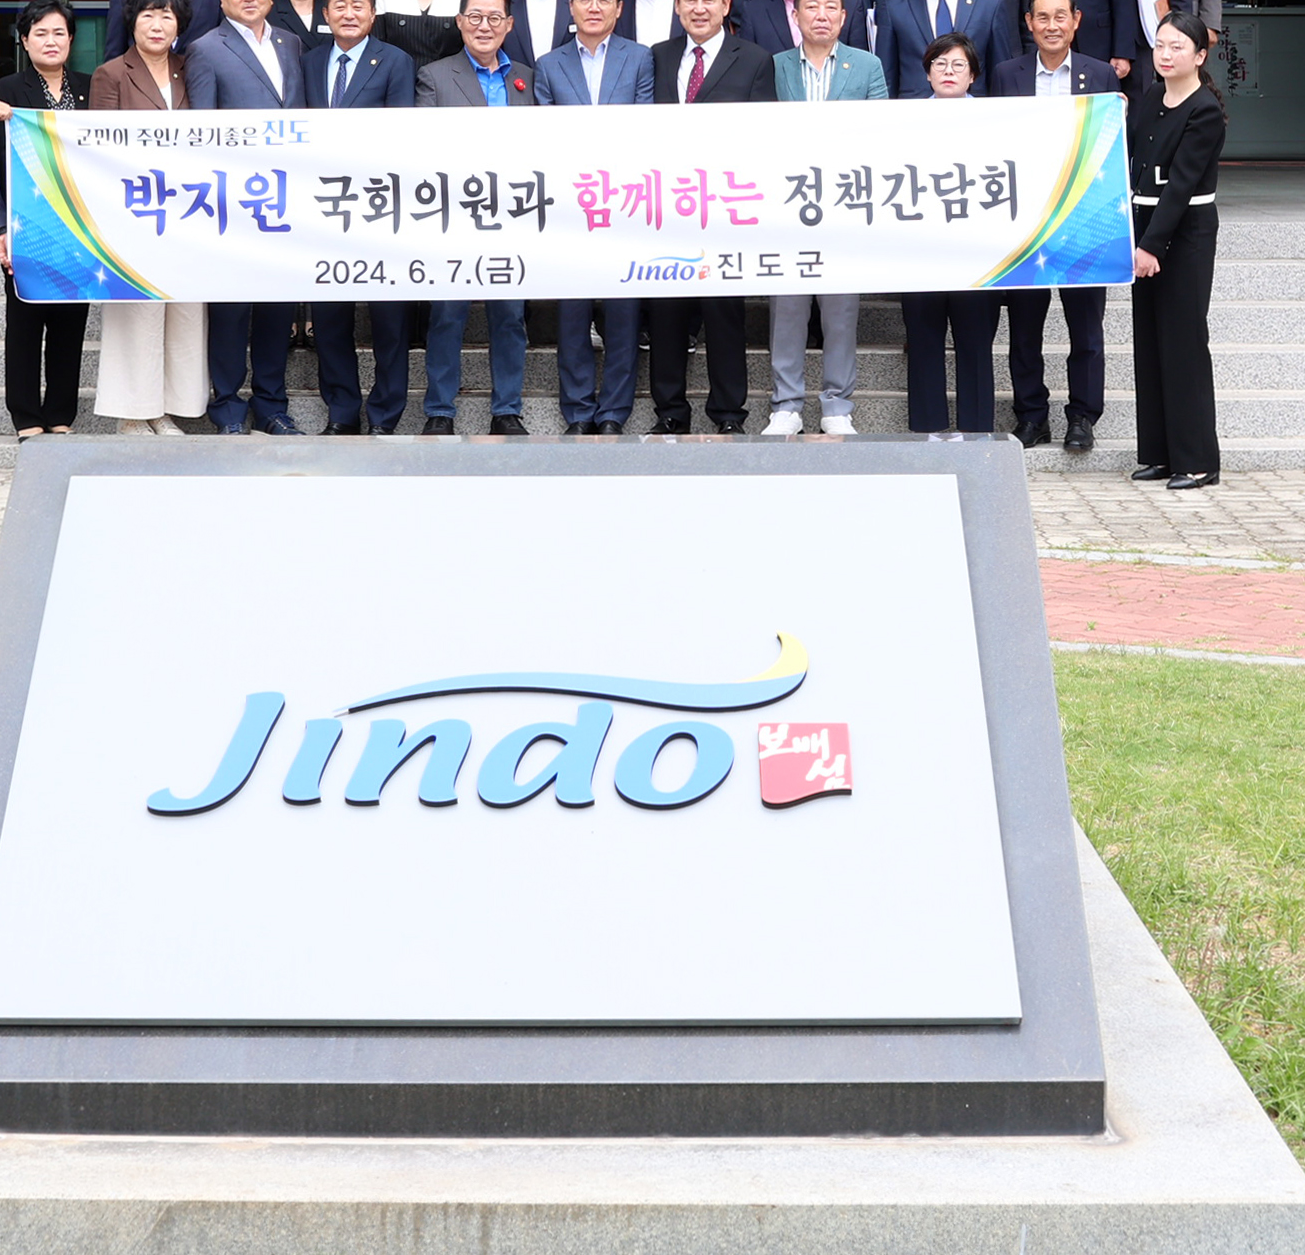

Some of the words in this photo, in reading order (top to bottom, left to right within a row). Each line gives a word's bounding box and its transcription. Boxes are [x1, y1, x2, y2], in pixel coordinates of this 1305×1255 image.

[77, 127, 129, 147] 군민이
[136, 127, 180, 148] 주인!
[186, 127, 258, 148] 살기좋은
[261, 119, 312, 146] 진도
[122, 168, 292, 237] 박지원
[313, 169, 555, 235] 국회의원과
[573, 168, 766, 232] 함께하는
[783, 159, 1020, 227] 정책간담회
[315, 259, 397, 286] 2024.
[620, 260, 696, 283] Jindo
[147, 691, 736, 818] Jindo
